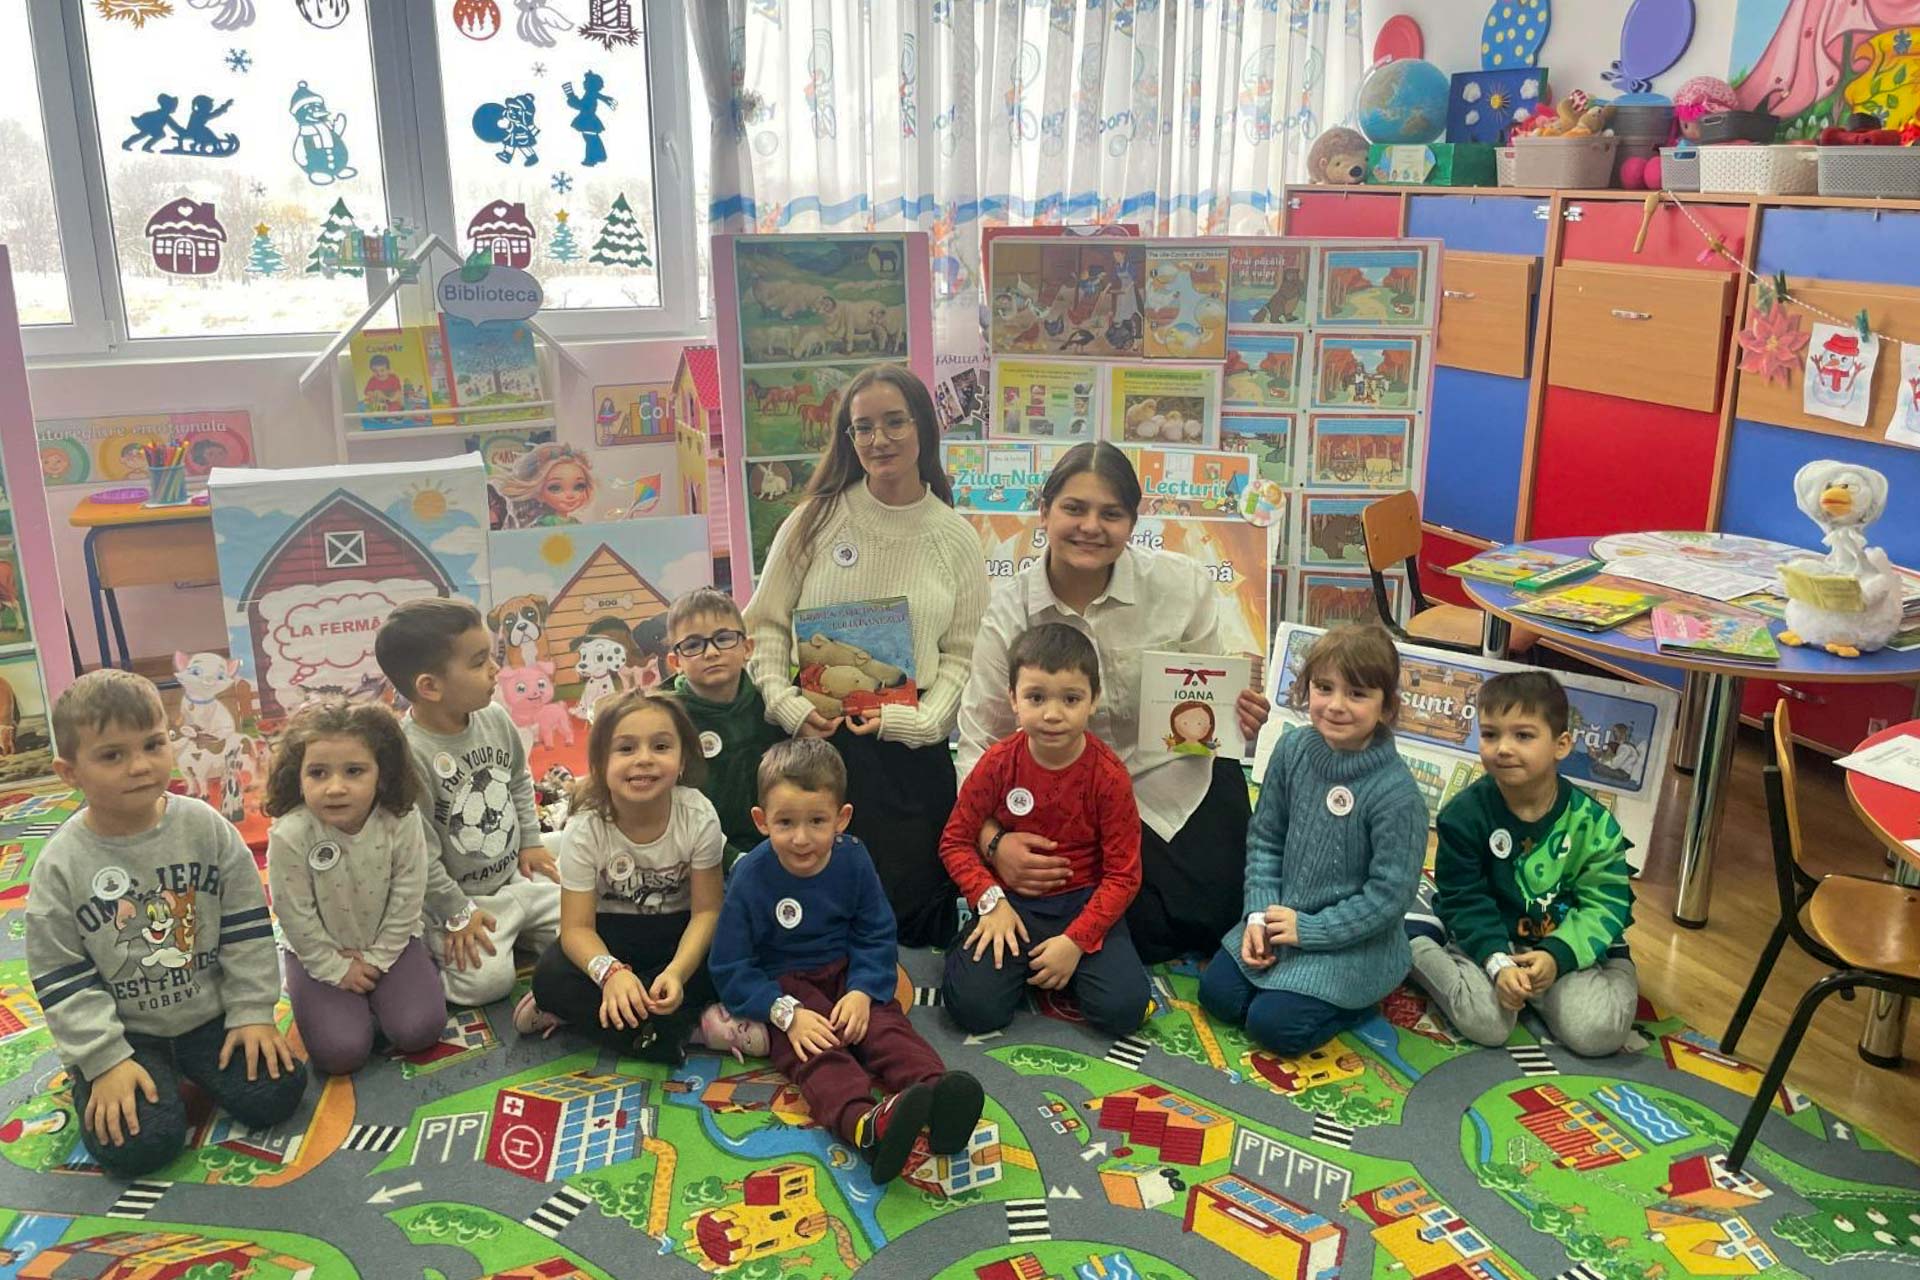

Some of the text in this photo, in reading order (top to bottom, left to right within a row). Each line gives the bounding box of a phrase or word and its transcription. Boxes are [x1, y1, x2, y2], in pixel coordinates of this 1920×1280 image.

[444, 285, 539, 302] Biblioteca
[956, 469, 1002, 486] Ziua
[1144, 477, 1228, 498] Lecturii
[1032, 527, 1048, 548] 5
[290, 625, 313, 638] LA
[1174, 690, 1215, 701] IOANA
[1400, 689, 1454, 715] sunt
[461, 746, 494, 770] YOUR
[495, 749, 513, 769] GO
[425, 1118, 479, 1140] P P
[1244, 1135, 1343, 1186] P P P P
